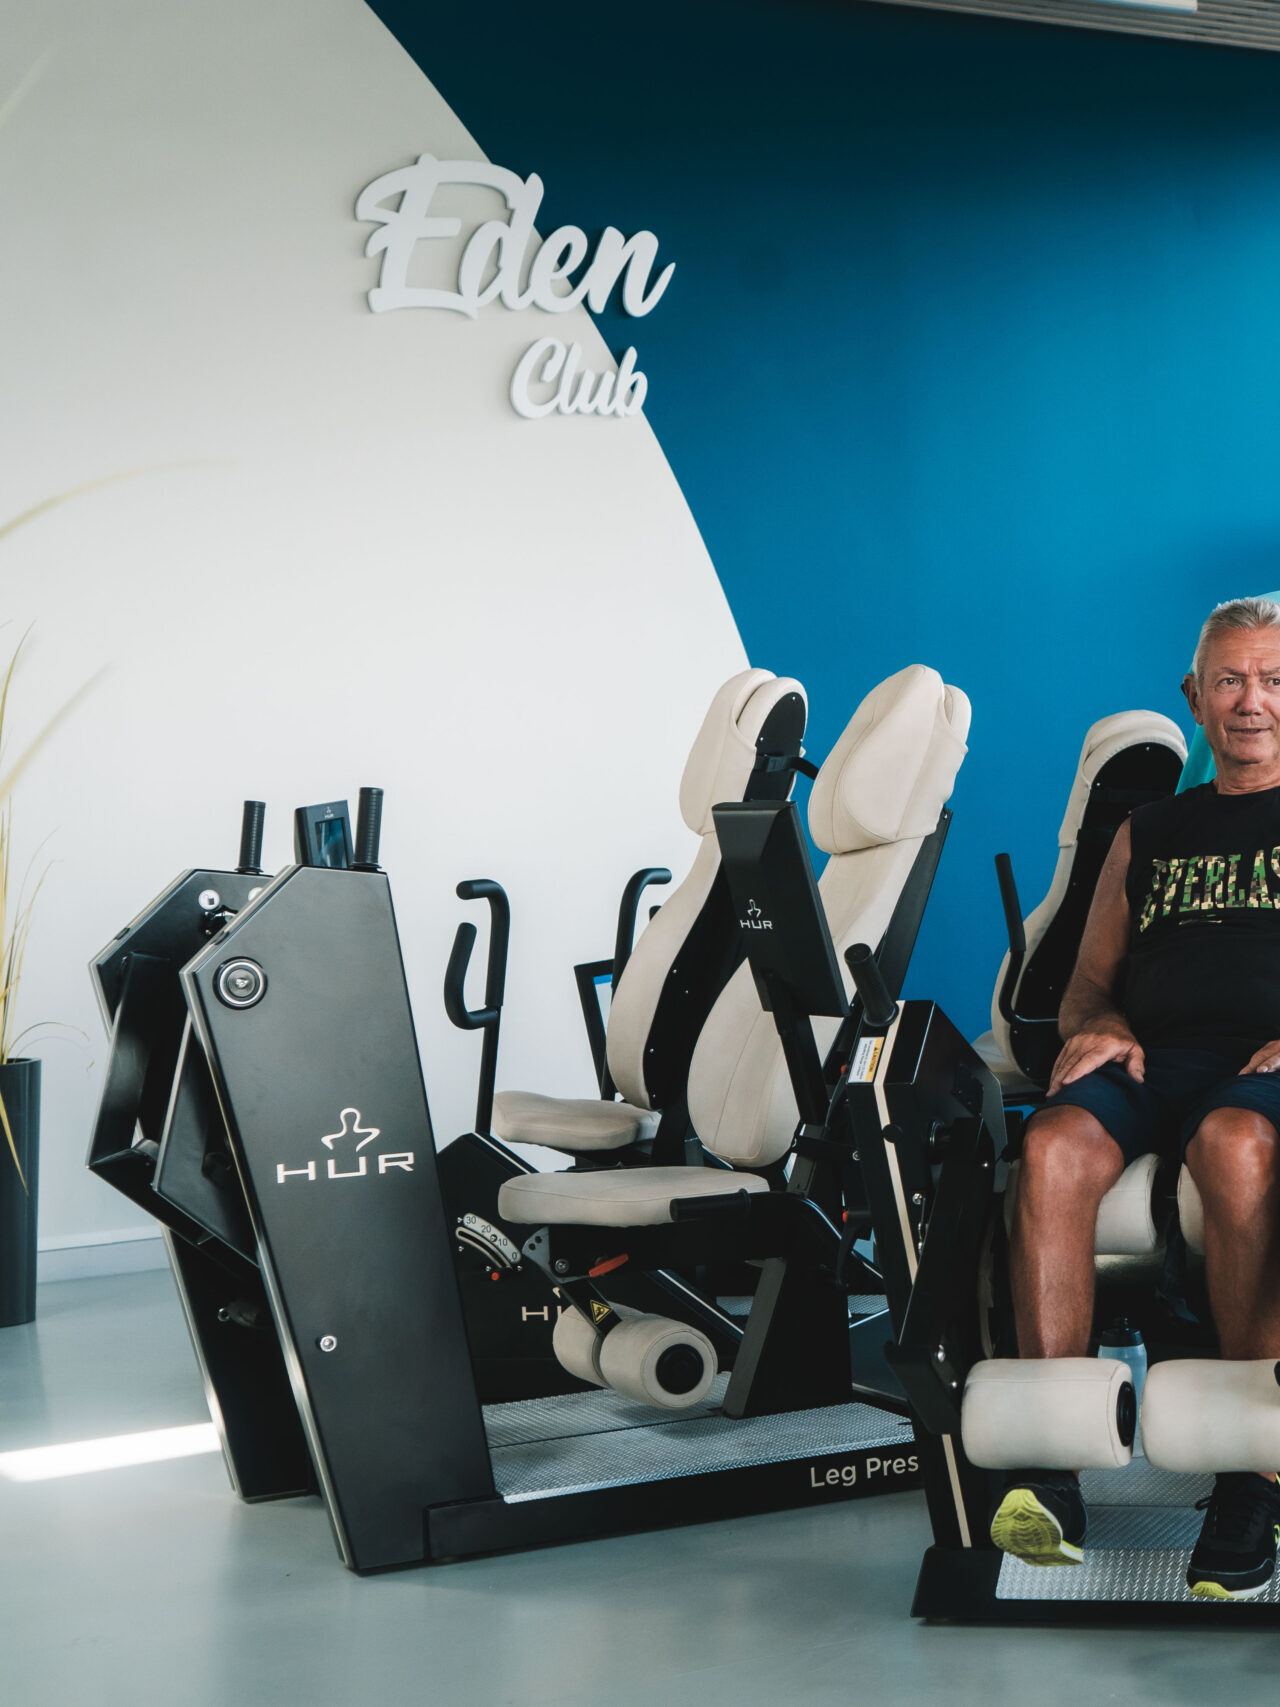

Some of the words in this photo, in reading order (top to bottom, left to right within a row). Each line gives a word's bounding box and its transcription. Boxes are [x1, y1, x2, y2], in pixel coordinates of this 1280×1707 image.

[355, 153, 676, 320] Eden
[510, 336, 648, 419] Club
[739, 919, 773, 930] HUR
[276, 1151, 415, 1184] HUR
[466, 1216, 477, 1225] 30
[481, 1225, 492, 1233] 20
[497, 1238, 508, 1247] 10
[511, 1251, 518, 1260] 0
[810, 1465, 856, 1488] Leg
[866, 1455, 919, 1479] Pres
